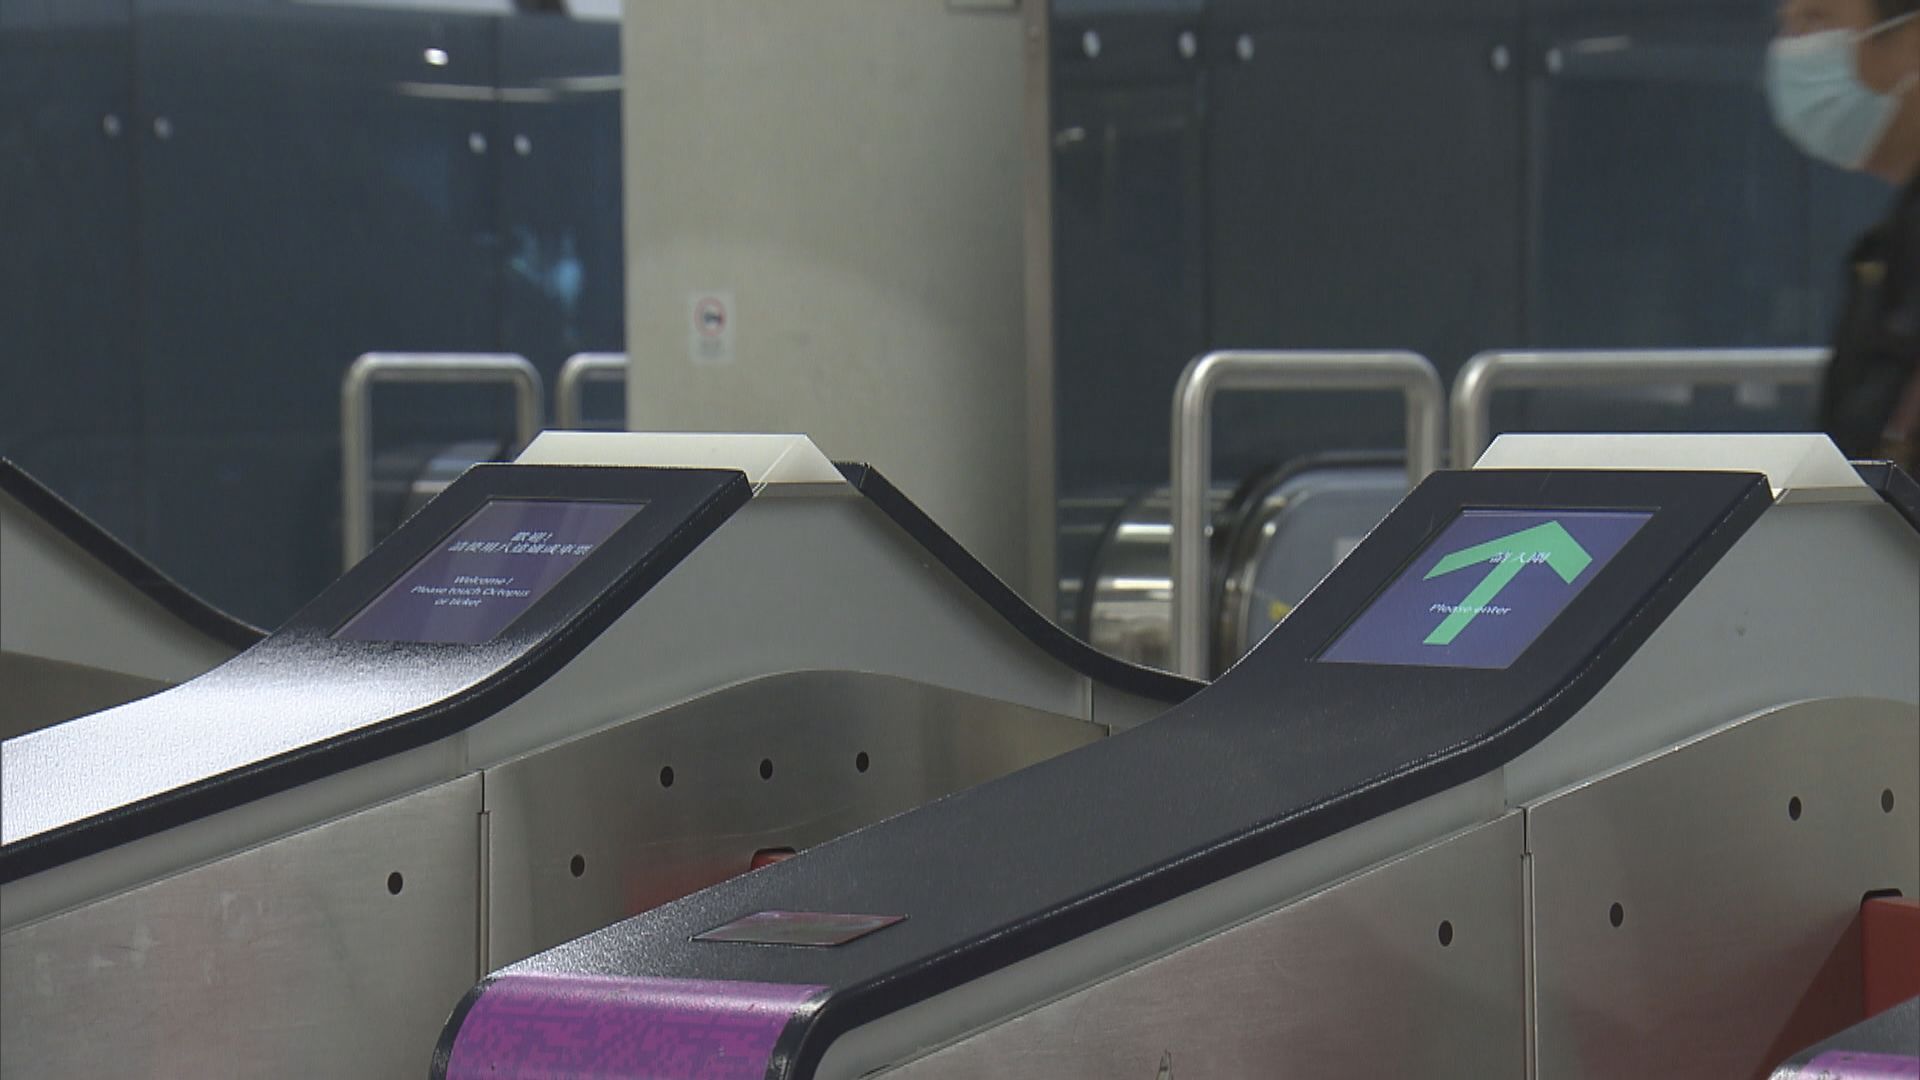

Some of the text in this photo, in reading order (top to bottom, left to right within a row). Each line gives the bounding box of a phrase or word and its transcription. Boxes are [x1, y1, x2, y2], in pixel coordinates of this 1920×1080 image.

[411, 586, 530, 598] Please touch Octopus
[448, 598, 482, 607] ticket
[1429, 604, 1511, 615] Please enter
